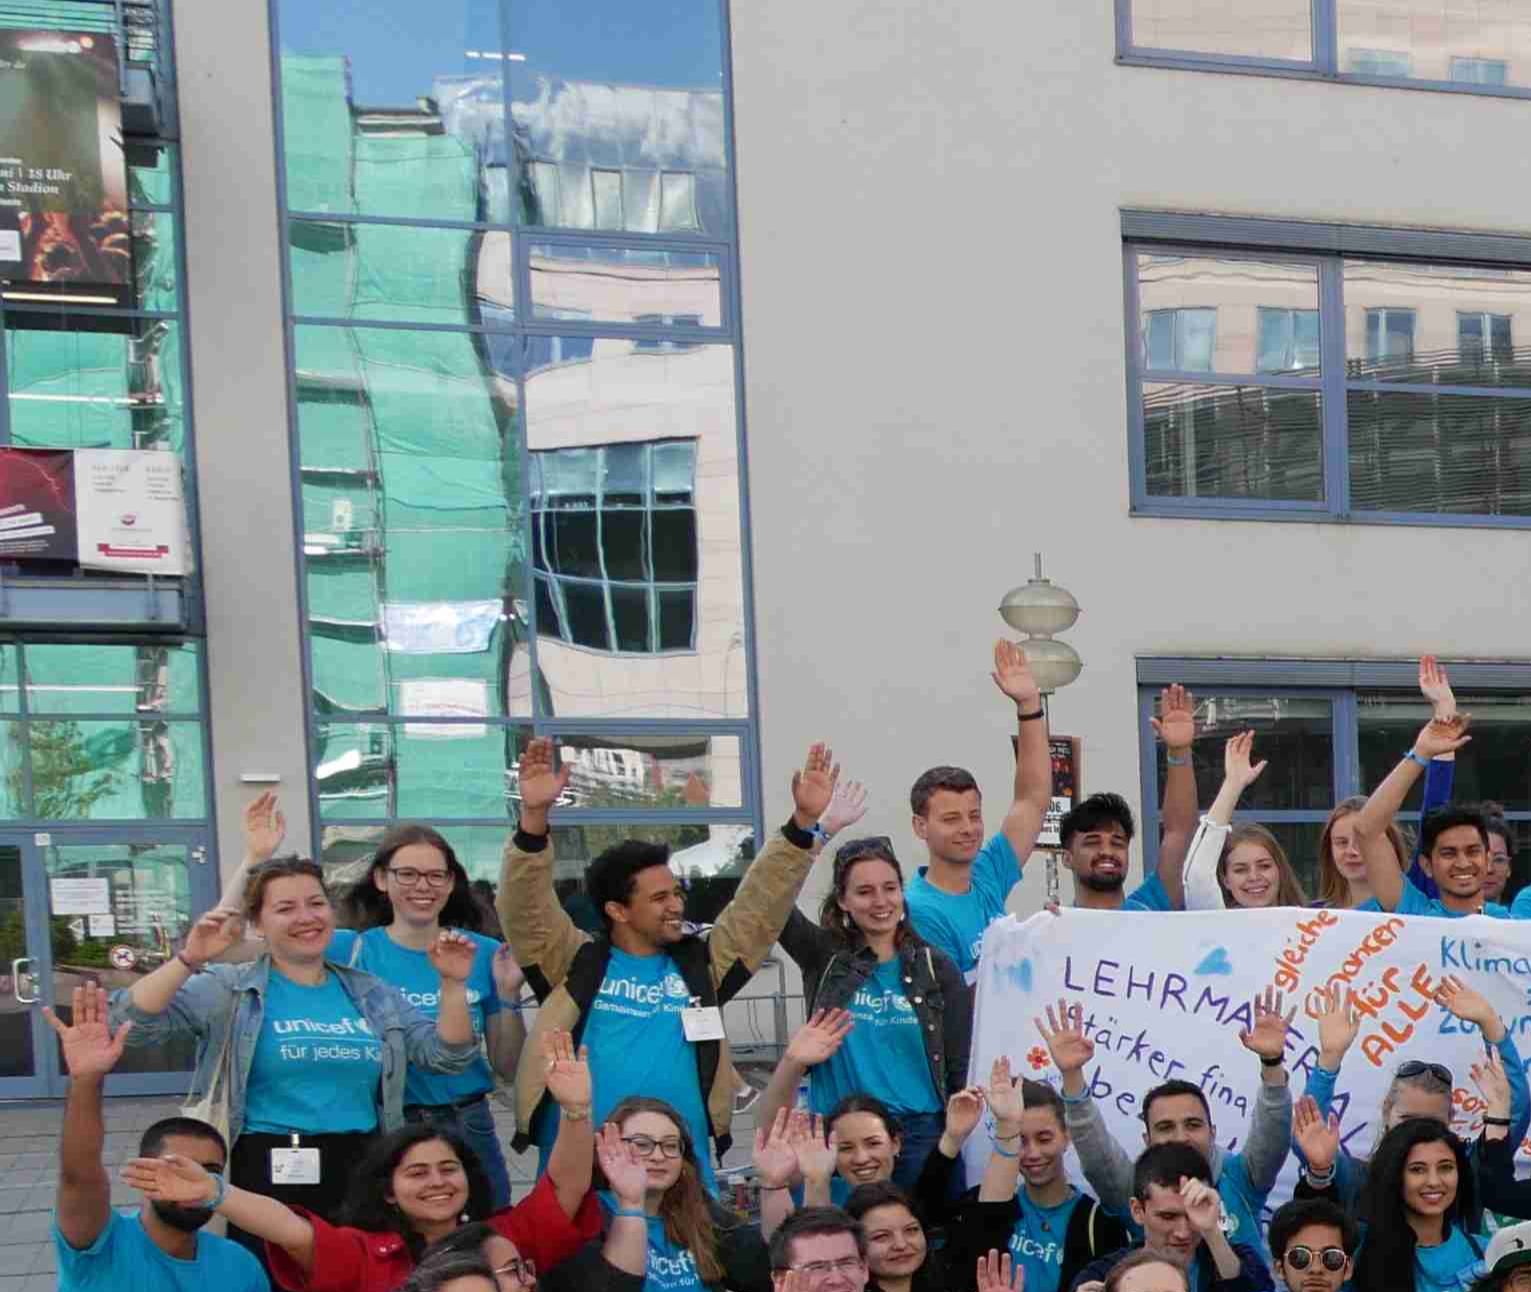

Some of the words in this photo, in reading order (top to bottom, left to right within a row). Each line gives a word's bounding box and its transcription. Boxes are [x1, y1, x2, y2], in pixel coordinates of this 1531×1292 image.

[8, 181, 59, 194] Stadion
[1275, 908, 1340, 993] gleiche
[274, 1014, 353, 1035] unicef
[1361, 961, 1440, 1067] ALLE
[280, 1042, 306, 1061] für
[312, 1043, 360, 1063] jedes
[1009, 1230, 1057, 1264] nicef
